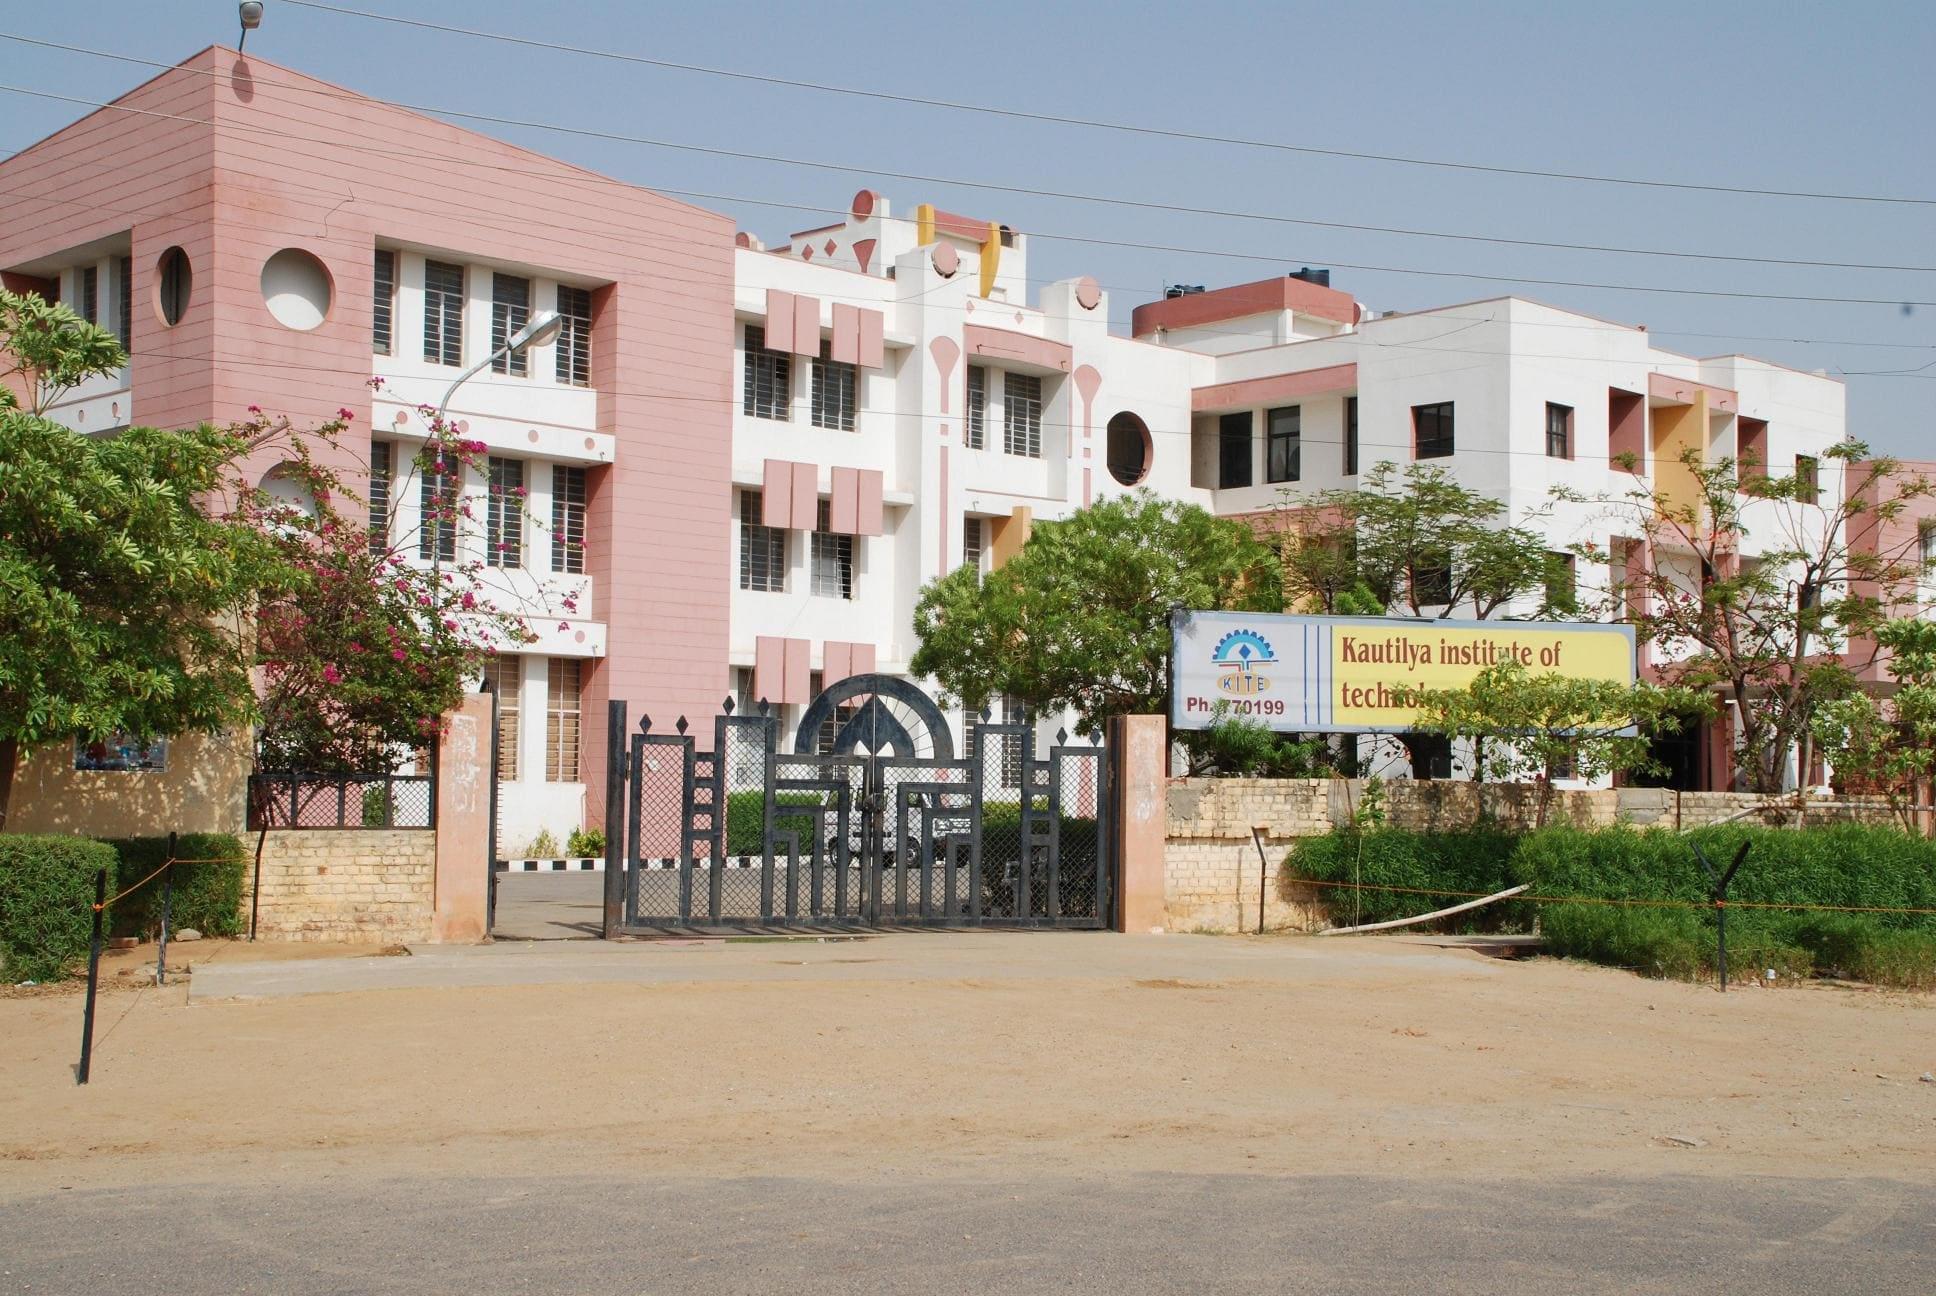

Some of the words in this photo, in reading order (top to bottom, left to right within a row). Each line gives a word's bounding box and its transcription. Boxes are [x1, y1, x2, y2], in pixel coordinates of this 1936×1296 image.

[1342, 637, 1432, 671] Kautilya
[1440, 638, 1533, 666] institute
[1540, 640, 1562, 666] of
[1223, 676, 1264, 692] KITE
[1187, 697, 1213, 712] Ph.
